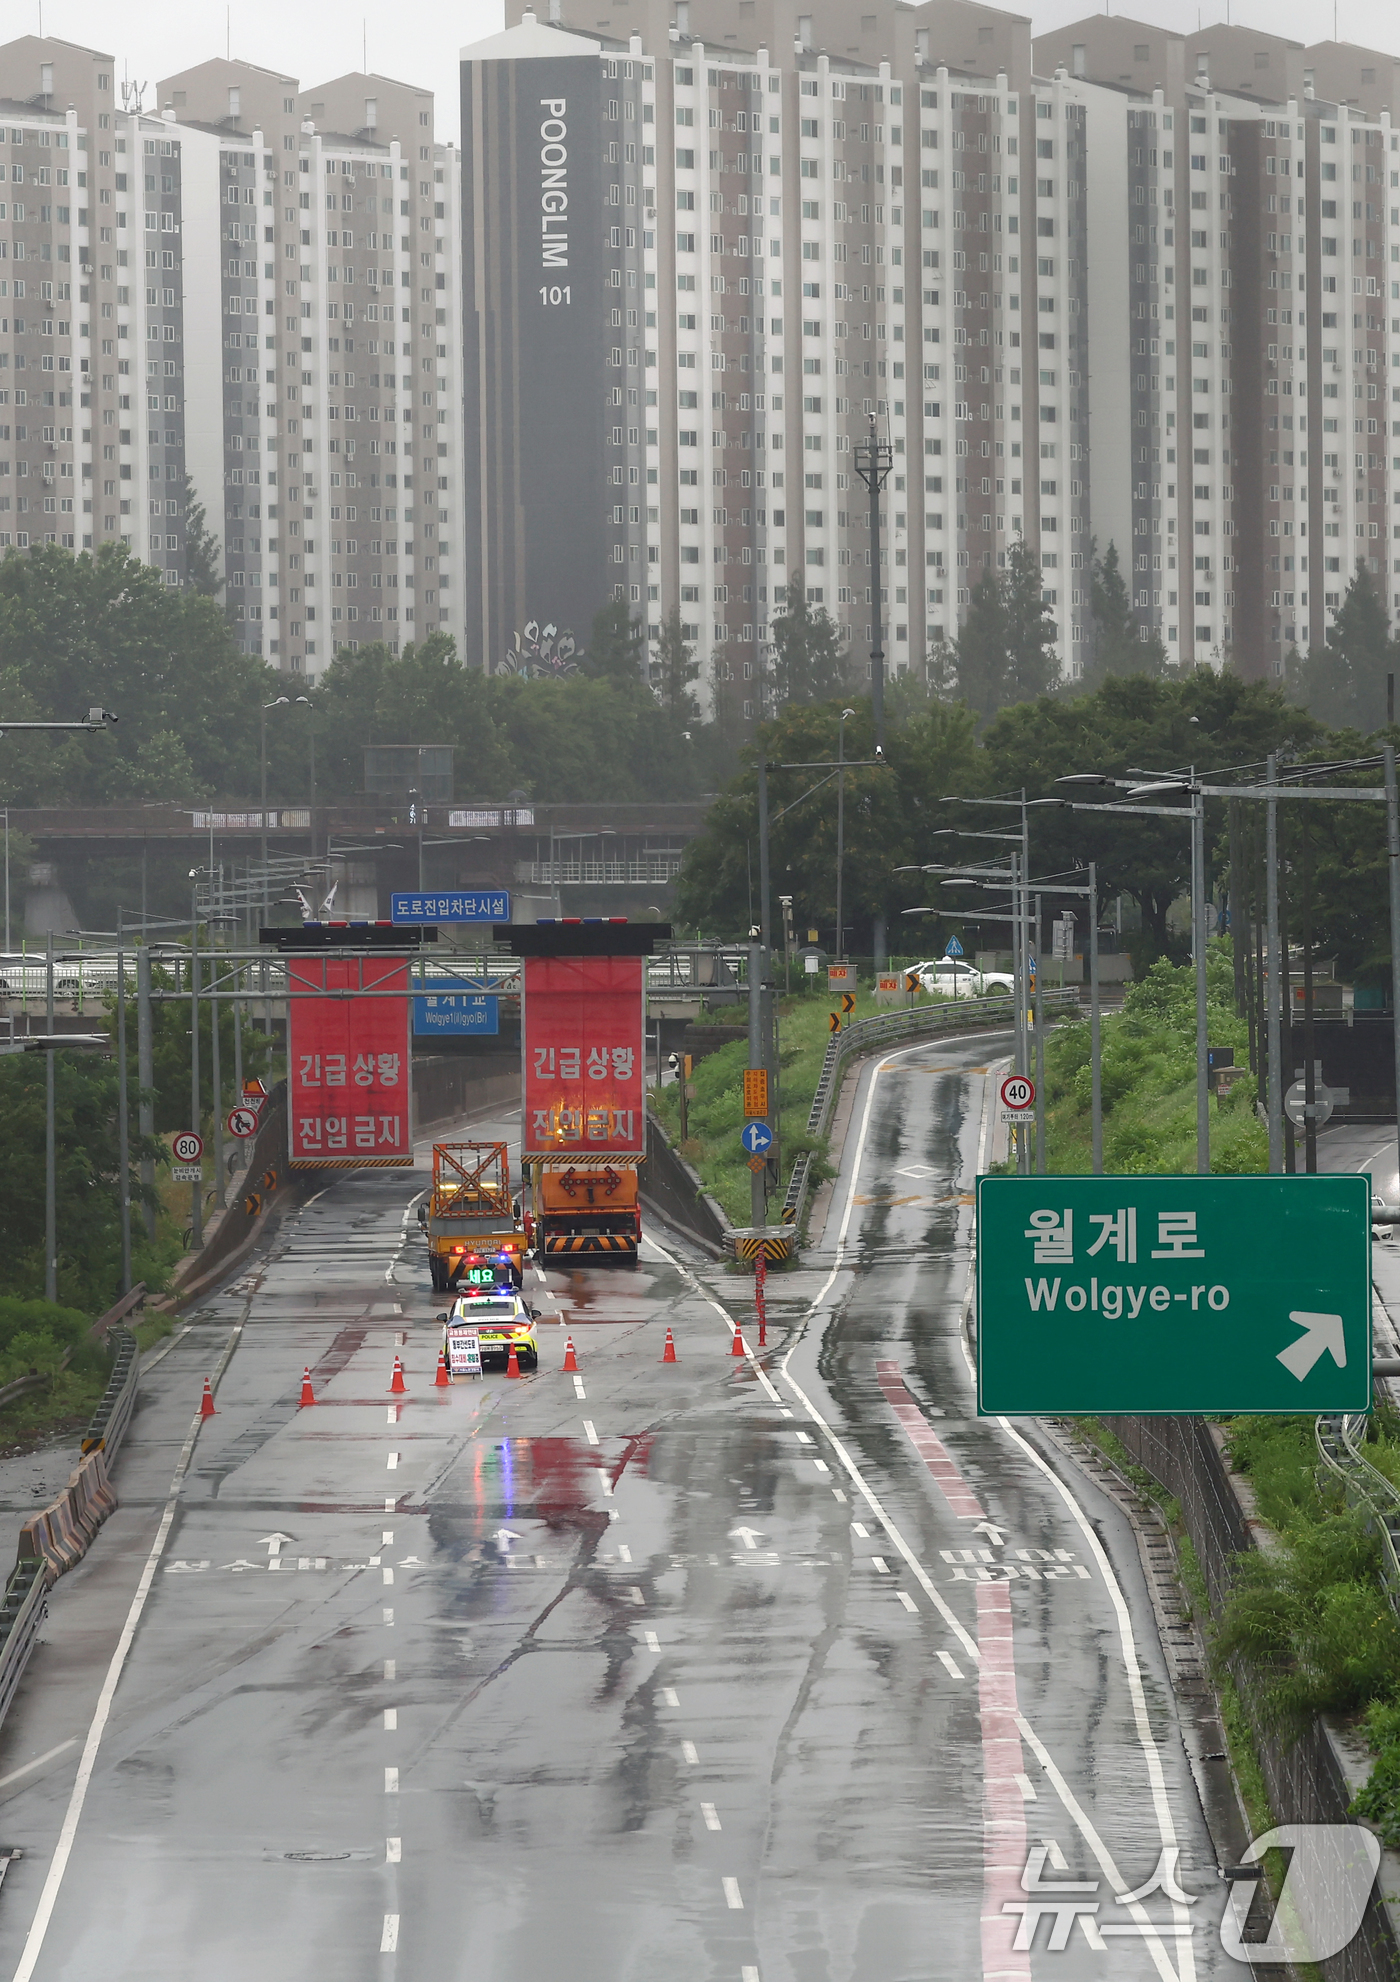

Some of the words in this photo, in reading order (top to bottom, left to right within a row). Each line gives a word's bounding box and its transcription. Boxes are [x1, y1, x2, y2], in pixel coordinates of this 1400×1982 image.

[540, 98, 569, 268] POONGLIM
[539, 285, 571, 305] 101
[396, 898, 504, 916] 도로진입차단시설
[1009, 1085, 1027, 1099] 40
[179, 1140, 197, 1155] 80
[1024, 1207, 1205, 1264] 월계로
[469, 1269, 494, 1284] 세요
[1024, 1277, 1230, 1320] Wolgye-ro
